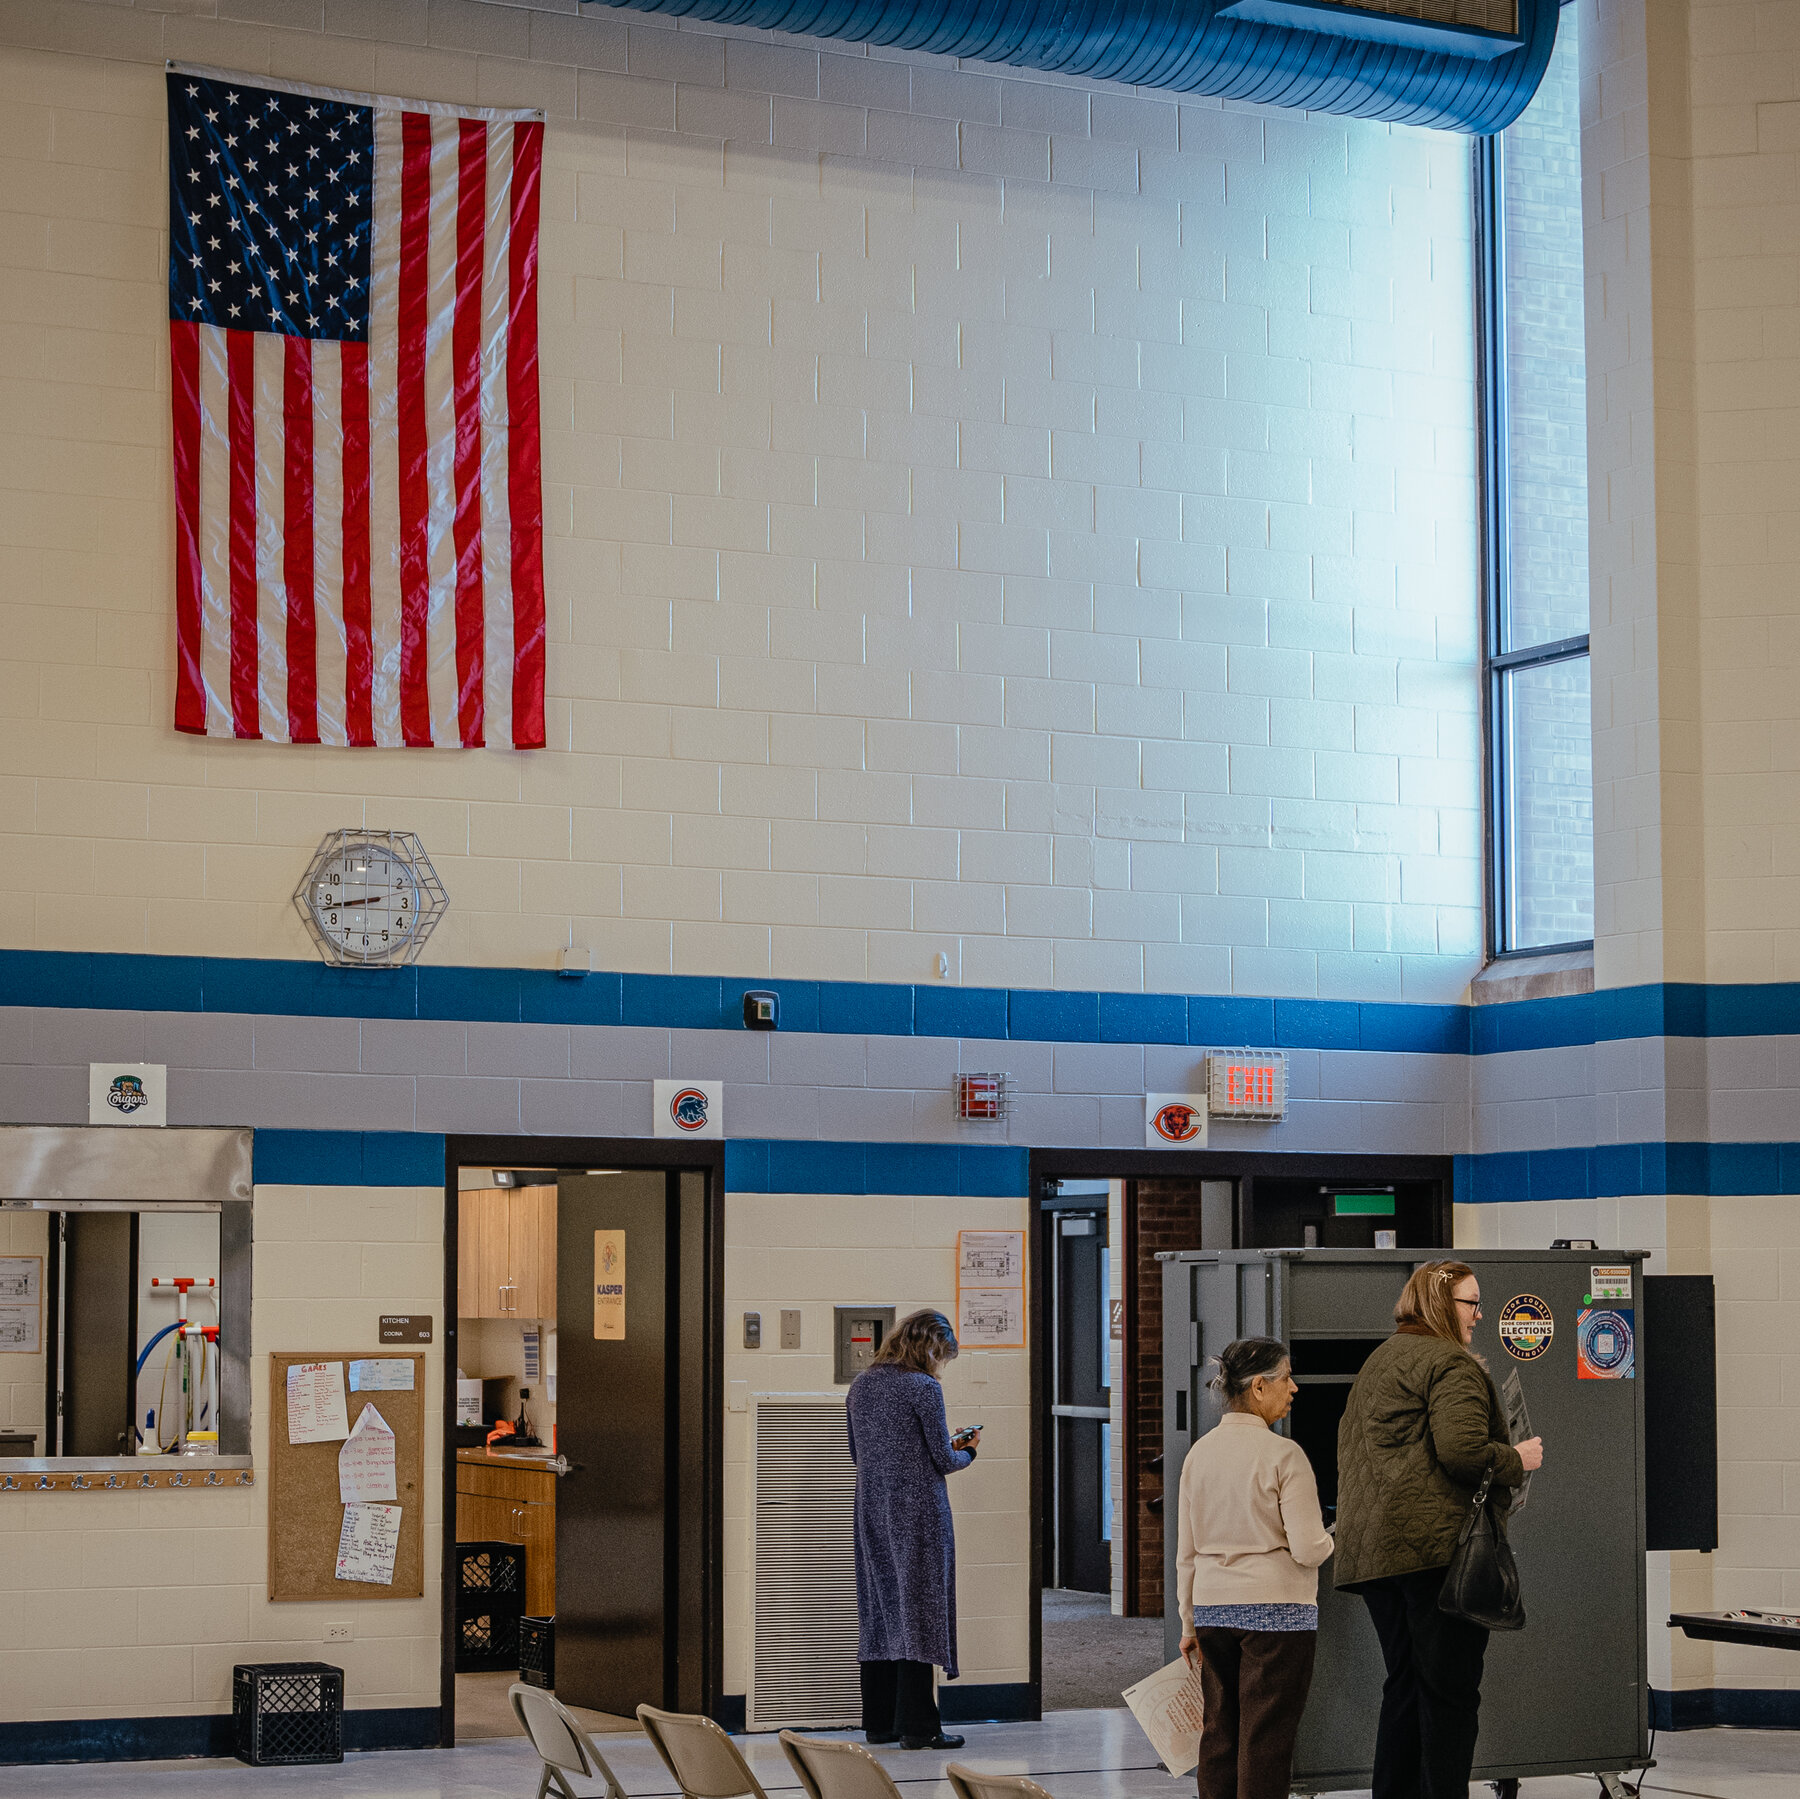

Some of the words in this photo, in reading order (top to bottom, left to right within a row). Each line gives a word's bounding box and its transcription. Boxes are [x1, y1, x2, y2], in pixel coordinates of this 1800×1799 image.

[345, 860, 353, 872] 11
[362, 856, 373, 868] 12
[329, 873, 340, 886] 10
[396, 878, 403, 889] 2
[325, 894, 332, 905] 9
[401, 898, 408, 909] 3
[330, 913, 337, 924] 8
[396, 917, 403, 929] 4
[344, 928, 351, 940] 7
[382, 930, 388, 941] 5
[362, 935, 369, 946] 6
[1228, 1066, 1276, 1106] EXIT
[108, 1091, 147, 1110] Cougars
[597, 1284, 623, 1296] KASPER
[597, 1296, 622, 1305] ENTRANCE
[1503, 1299, 1521, 1319] COOK
[1523, 1297, 1549, 1318] COUNTY
[1501, 1327, 1552, 1335] ELECTIONS
[1509, 1345, 1544, 1357] ILLINOIS
[301, 1364, 327, 1373] GAMES
